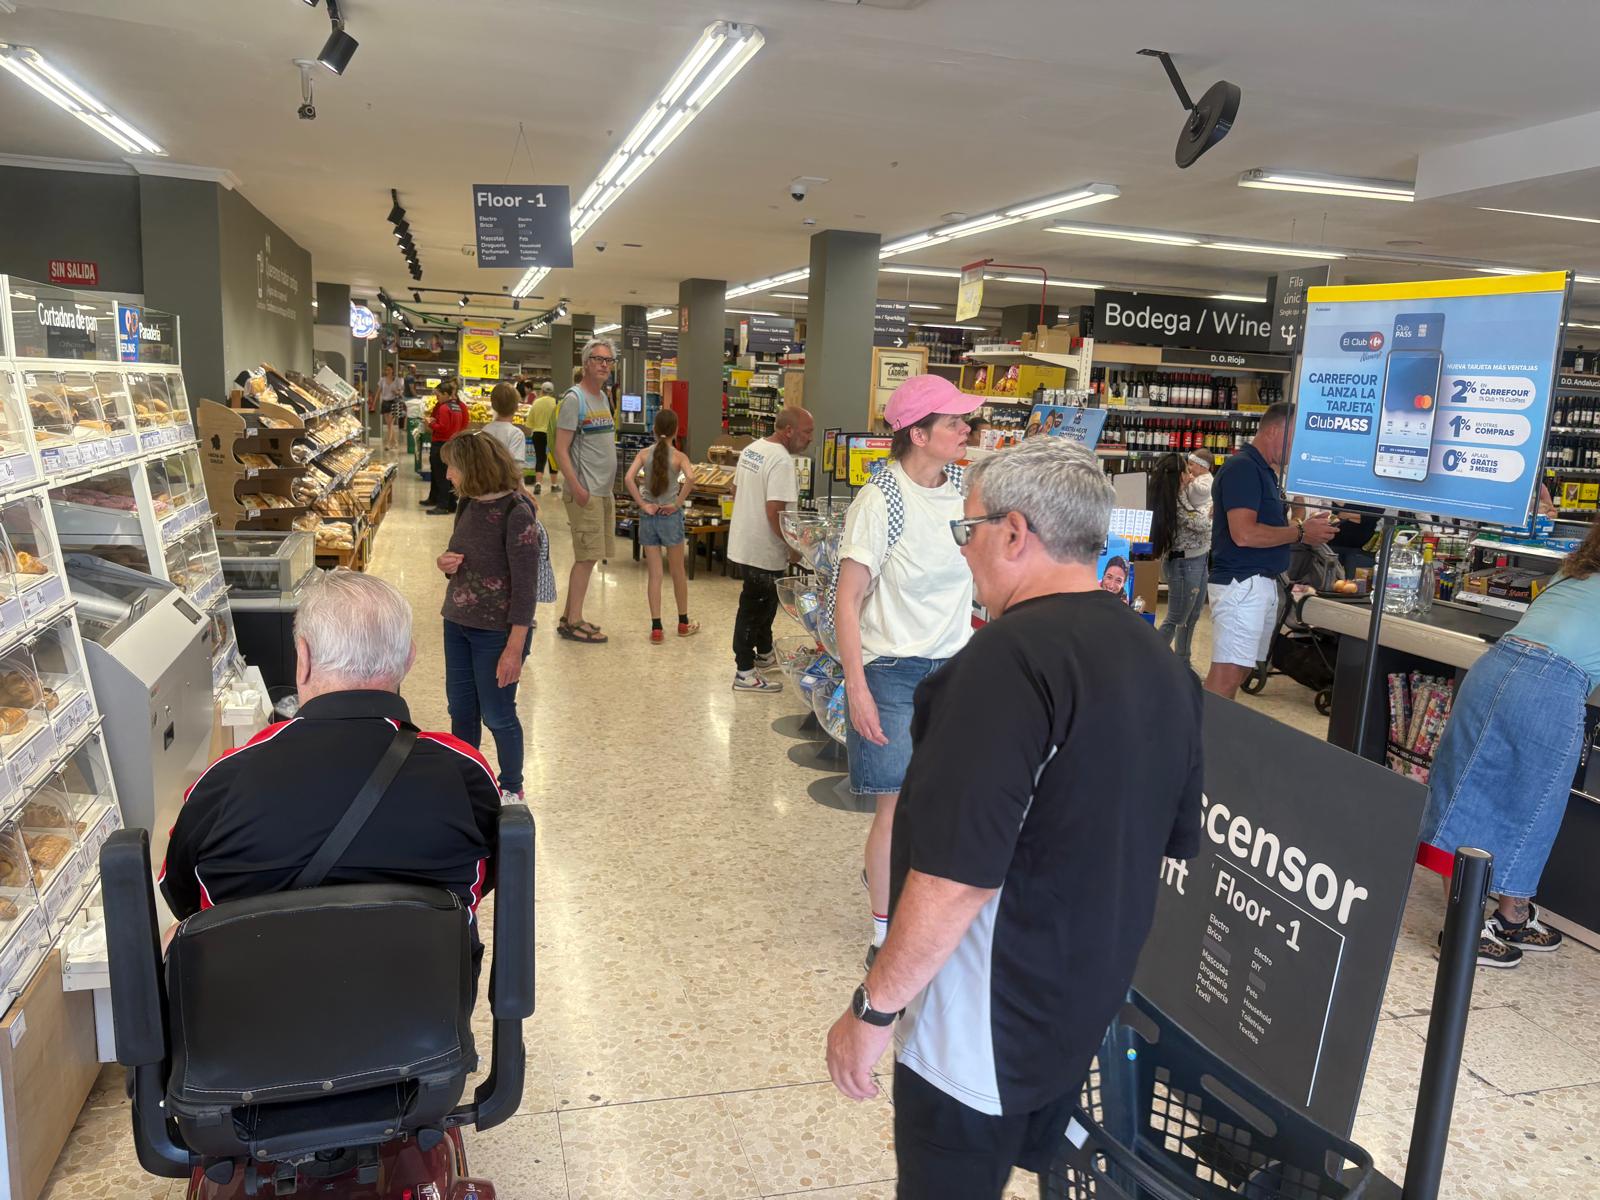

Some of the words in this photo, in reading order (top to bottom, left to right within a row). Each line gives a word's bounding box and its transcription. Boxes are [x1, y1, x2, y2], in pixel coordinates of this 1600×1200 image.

[477, 192, 522, 208] Floor
[528, 193, 546, 208] -1
[52, 262, 65, 278] SIN
[66, 262, 96, 280] SALIDA
[1289, 276, 1304, 288] Fila
[1284, 292, 1301, 304] únic
[38, 302, 76, 329] Cortadora
[76, 310, 86, 331] de
[85, 315, 98, 334] pan
[1106, 302, 1191, 336] Bodega
[1196, 308, 1206, 334] /
[1212, 310, 1271, 337] Wine
[1352, 338, 1368, 346] Club
[1228, 355, 1245, 365] Rioja
[1309, 373, 1378, 385] CARREFOUR
[1321, 386, 1357, 398] LANZA
[1360, 387, 1376, 399] LA
[1450, 380, 1477, 403] 2%
[1308, 415, 1368, 432] ClubPASS
[1449, 416, 1471, 438] 1%
[1475, 428, 1514, 436] COMPRAS
[1442, 449, 1467, 472] 0%
[1470, 458, 1498, 466] GRATIS
[1215, 870, 1271, 927] Floor
[1276, 919, 1300, 952] -1
[1209, 913, 1230, 934] Electro
[1207, 925, 1222, 942] Brico
[1202, 948, 1228, 976] Mascotas
[1251, 960, 1262, 972] DIY
[1254, 947, 1272, 966] Electro
[1200, 961, 1228, 989] Droguería
[1195, 984, 1211, 1003] Textil
[1197, 972, 1228, 1004] Perfumería
[1245, 985, 1258, 999] Pets
[1243, 998, 1272, 1024] Household
[1241, 1009, 1265, 1034] Toiletries
[1238, 1021, 1259, 1044] Textiles
